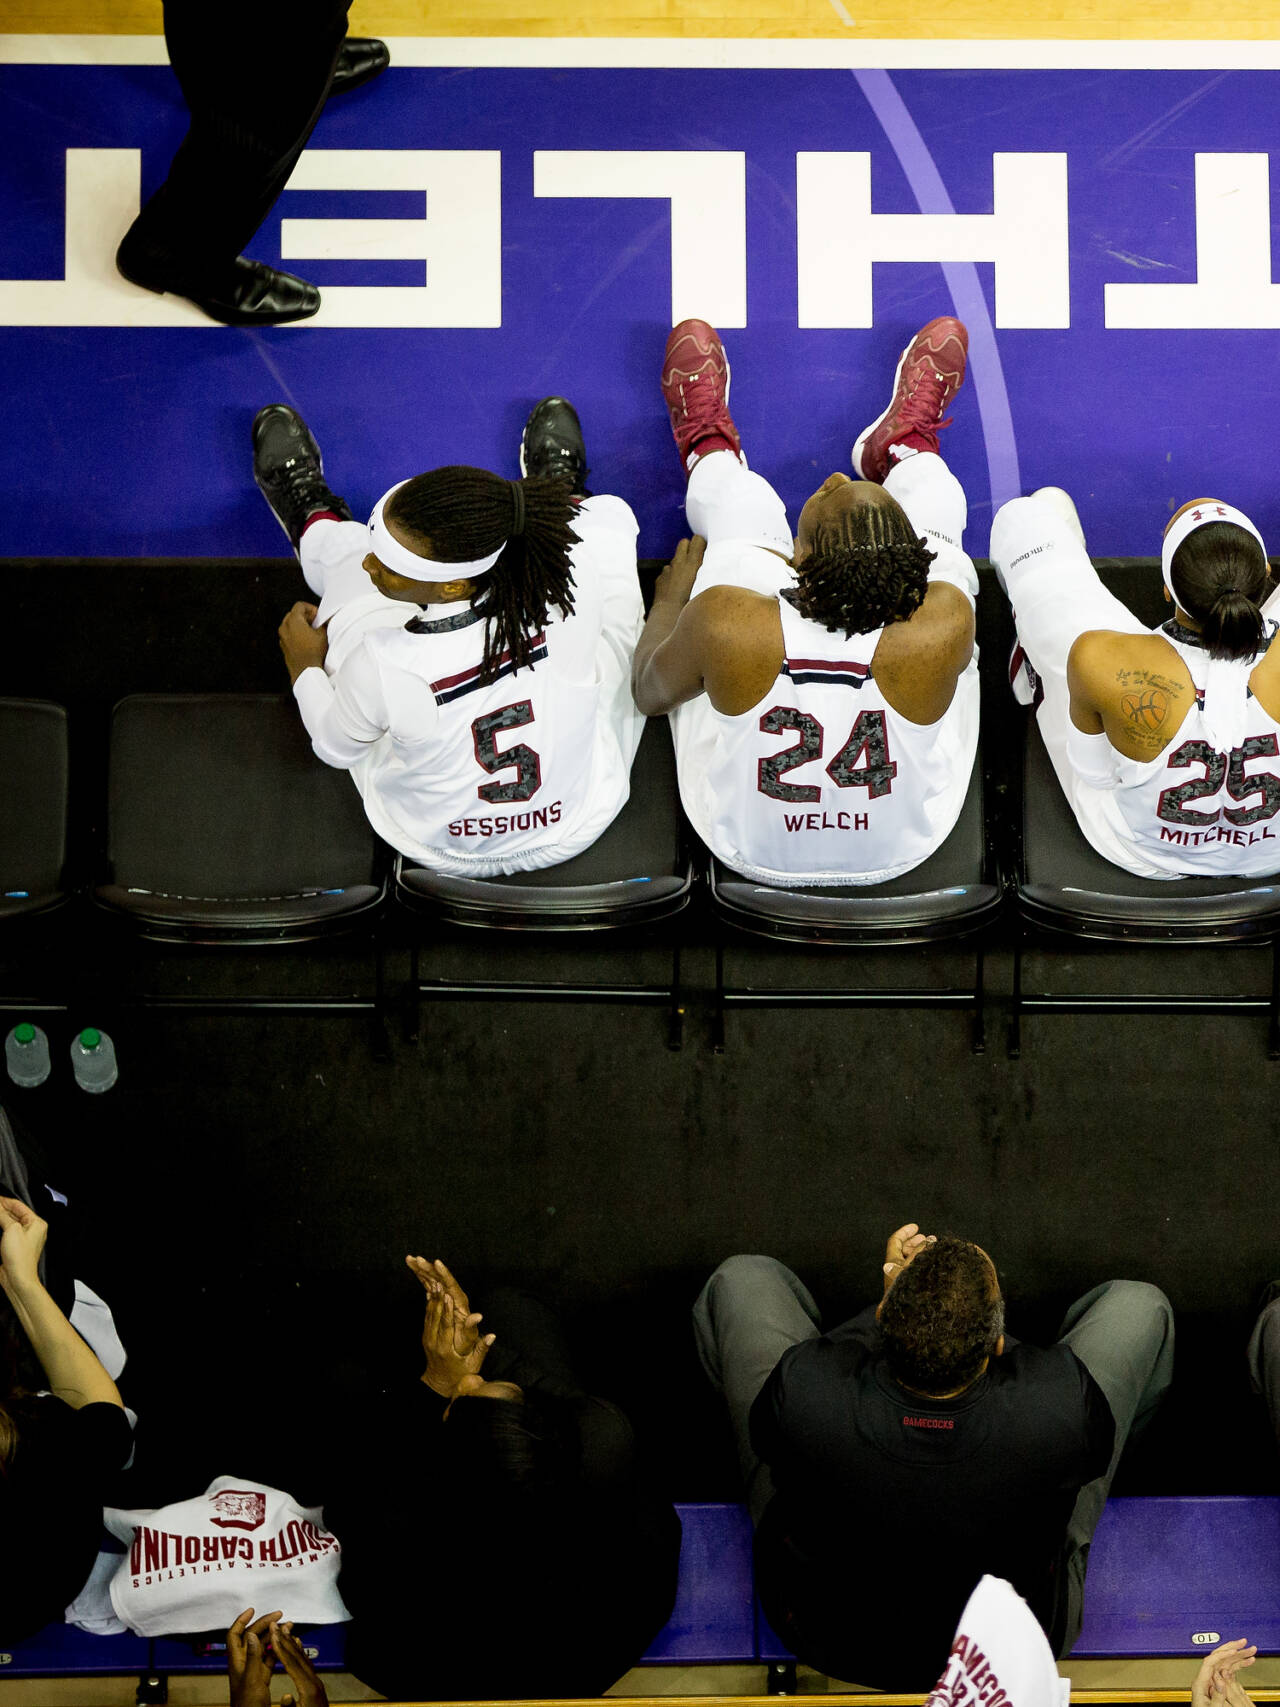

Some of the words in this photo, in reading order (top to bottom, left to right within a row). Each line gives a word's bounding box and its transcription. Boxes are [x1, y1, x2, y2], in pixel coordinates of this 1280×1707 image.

[472, 698, 541, 803] 5
[758, 706, 898, 803] 24
[449, 800, 563, 837] SESSIONS
[784, 812, 869, 833] WELCH
[1160, 824, 1277, 848] MITCHELL
[903, 1416, 954, 1429] GAMECOCKS
[130, 1526, 253, 1575] CAROLINA
[131, 1561, 235, 1589] ATHLETICS
[1197, 1633, 1213, 1643] 10
